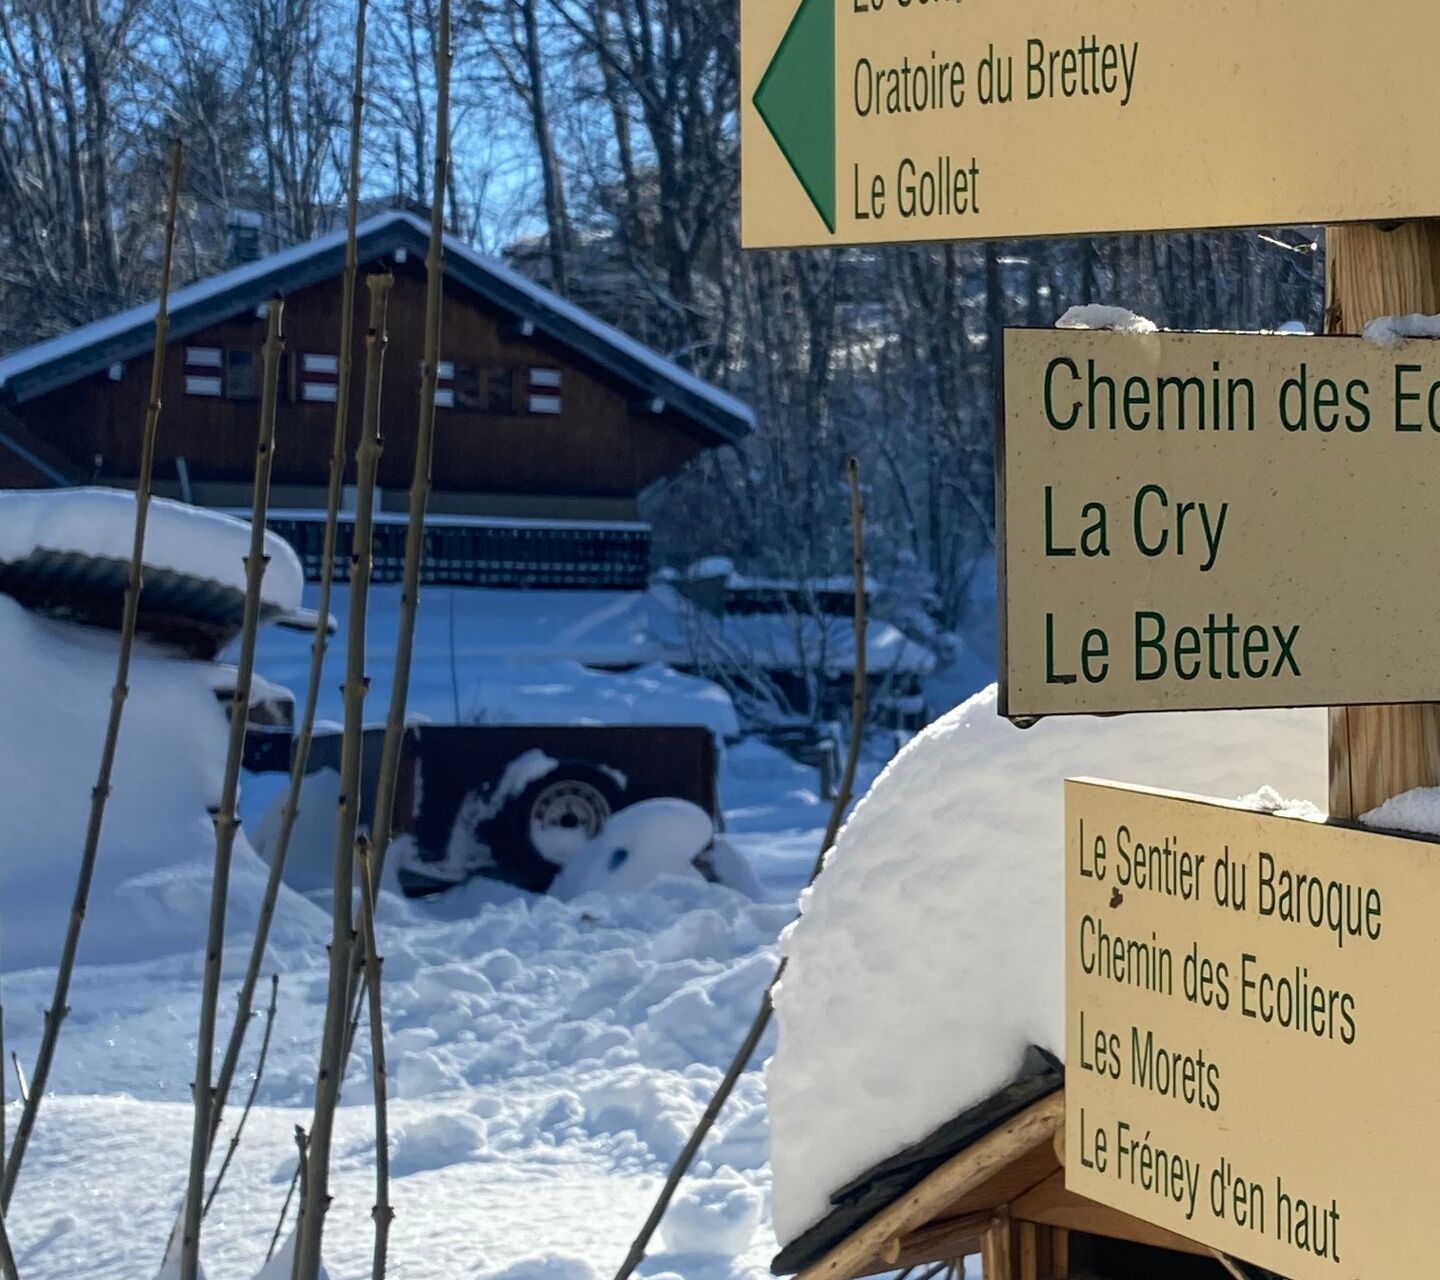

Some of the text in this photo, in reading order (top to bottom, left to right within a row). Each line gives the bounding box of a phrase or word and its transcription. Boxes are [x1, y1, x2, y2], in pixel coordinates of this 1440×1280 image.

[855, 35, 1138, 117] Oratoire du Brettey
[855, 156, 979, 219] Le Gollet
[1044, 357, 1254, 431] Chemin
[1279, 363, 1370, 432] des
[1045, 485, 1228, 571] La Cry
[1046, 612, 1301, 684] Le Bettex
[1080, 819, 1381, 948] Le Sentier du Baroque
[1081, 915, 1355, 1044] Chemin des Ecoliers
[1081, 1011, 1219, 1111] Les Morets
[1081, 1108, 1339, 1263] Le Fréney d'en haut
